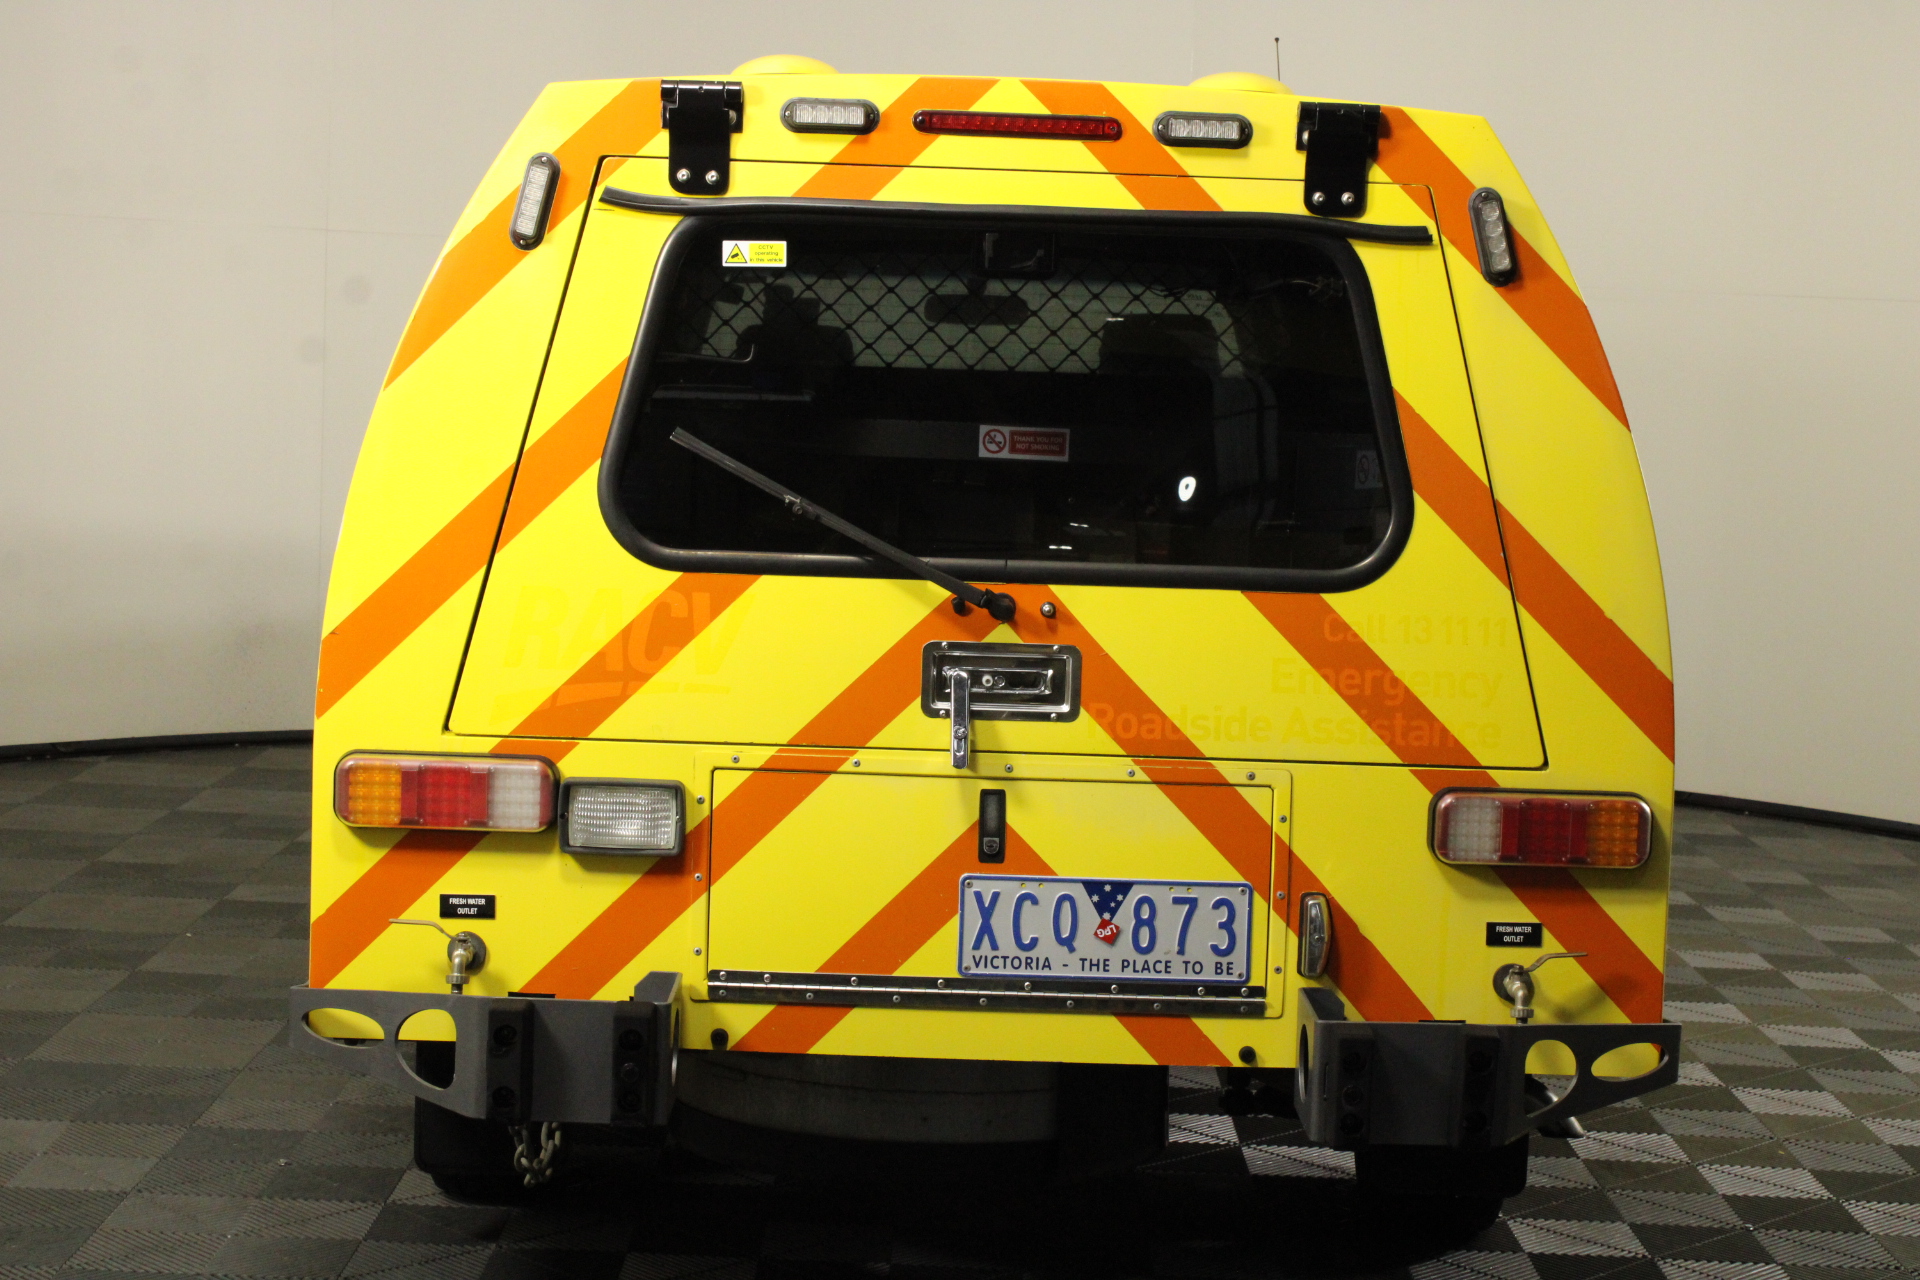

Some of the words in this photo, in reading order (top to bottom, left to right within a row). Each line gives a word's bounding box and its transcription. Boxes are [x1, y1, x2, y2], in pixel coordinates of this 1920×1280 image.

[1013, 435, 1034, 443] THANK
[1030, 443, 1060, 451] SMOKING
[503, 585, 756, 676] RACV
[1323, 613, 1386, 643] Call
[1400, 614, 1433, 644] 13
[1271, 657, 1504, 707] Emergency
[1087, 702, 1273, 744] Roadside
[1281, 706, 1501, 749] Assistance
[449, 897, 467, 905] FRESH
[457, 907, 478, 915] OUTLET
[971, 889, 1079, 954] XCQ
[1131, 893, 1237, 957] 873
[1097, 924, 1117, 938] LPG
[1503, 935, 1524, 943] OUTLET
[972, 954, 1052, 971] VICTORIA
[1079, 958, 1110, 973] THE
[1121, 959, 1172, 974] PLACE
[1183, 961, 1204, 975] TO
[1215, 962, 1234, 976] BE
